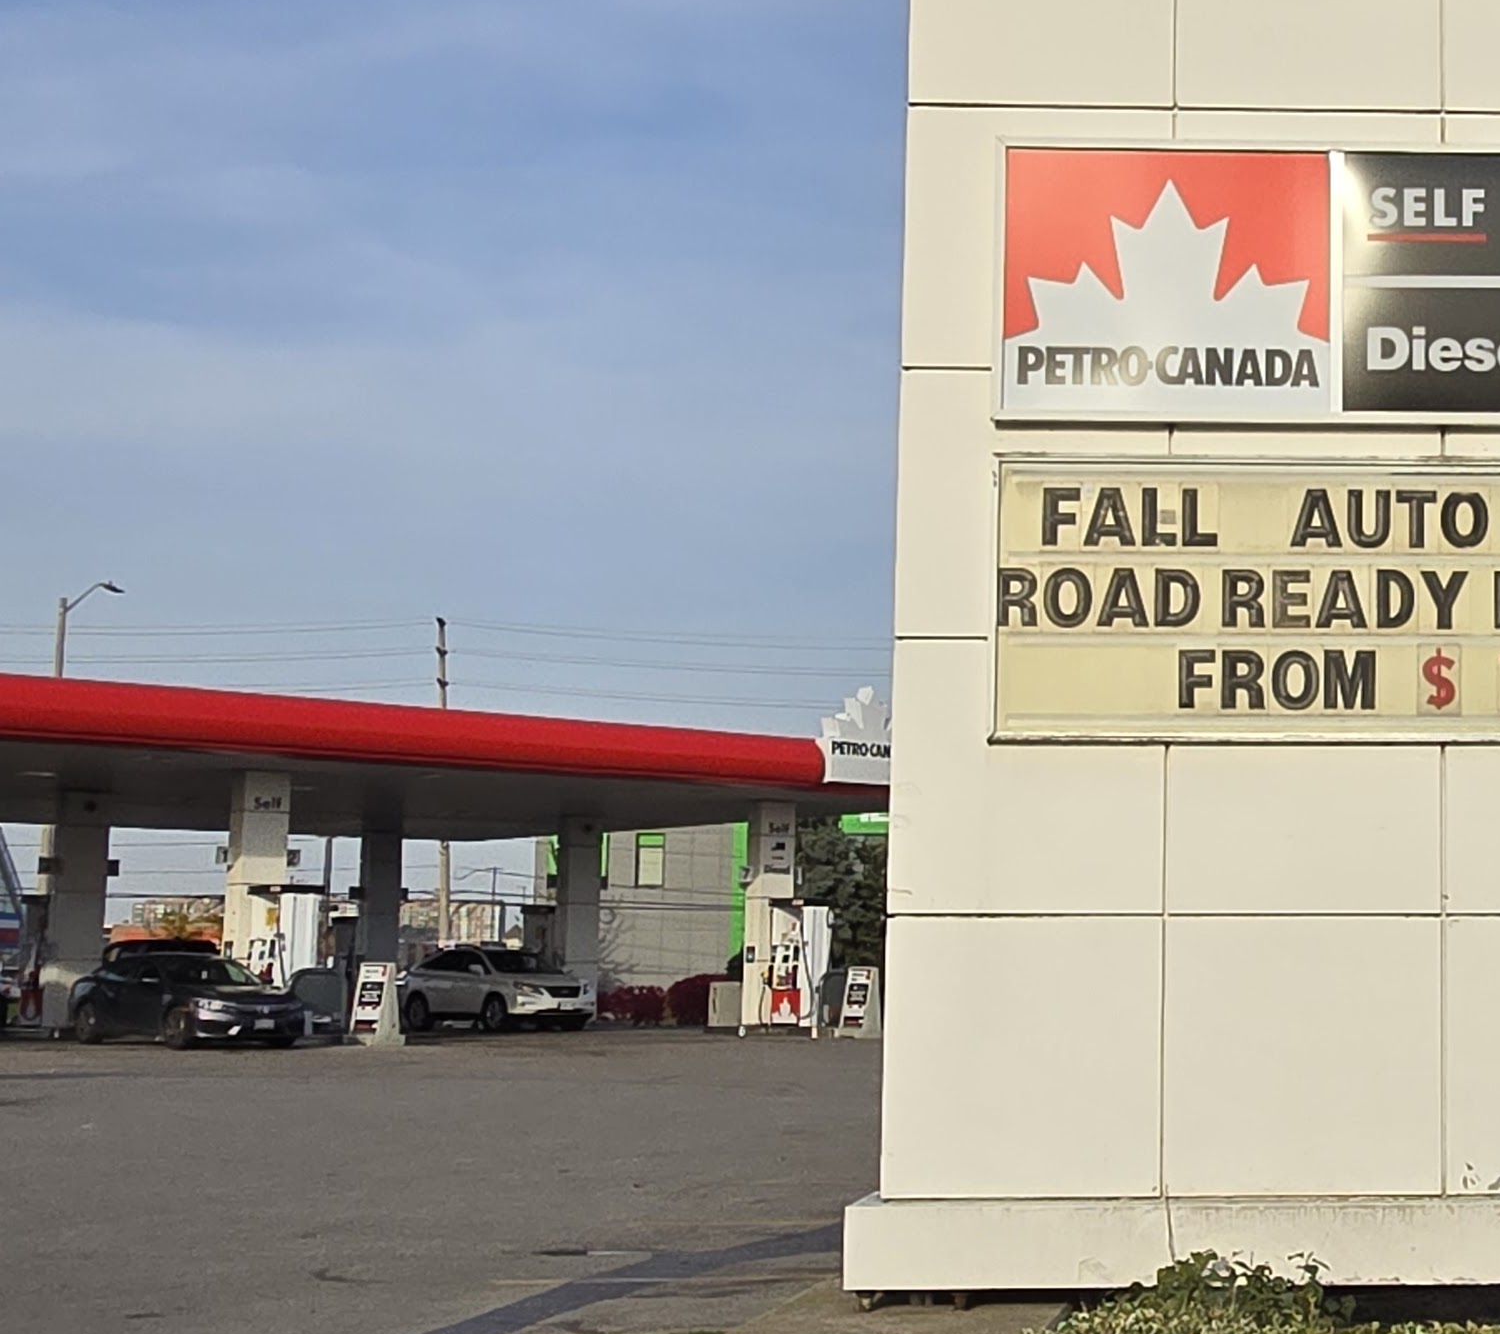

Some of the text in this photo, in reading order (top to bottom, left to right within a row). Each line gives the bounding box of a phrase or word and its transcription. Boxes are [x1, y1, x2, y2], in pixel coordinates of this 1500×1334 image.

[1368, 186, 1487, 228] SELF
[1041, 487, 1219, 548] FALL
[1290, 489, 1490, 550] AUTO
[999, 567, 1200, 629] ROAD
[1221, 569, 1469, 630] READY
[1178, 649, 1377, 711] FROM
[1421, 647, 1458, 711] $
